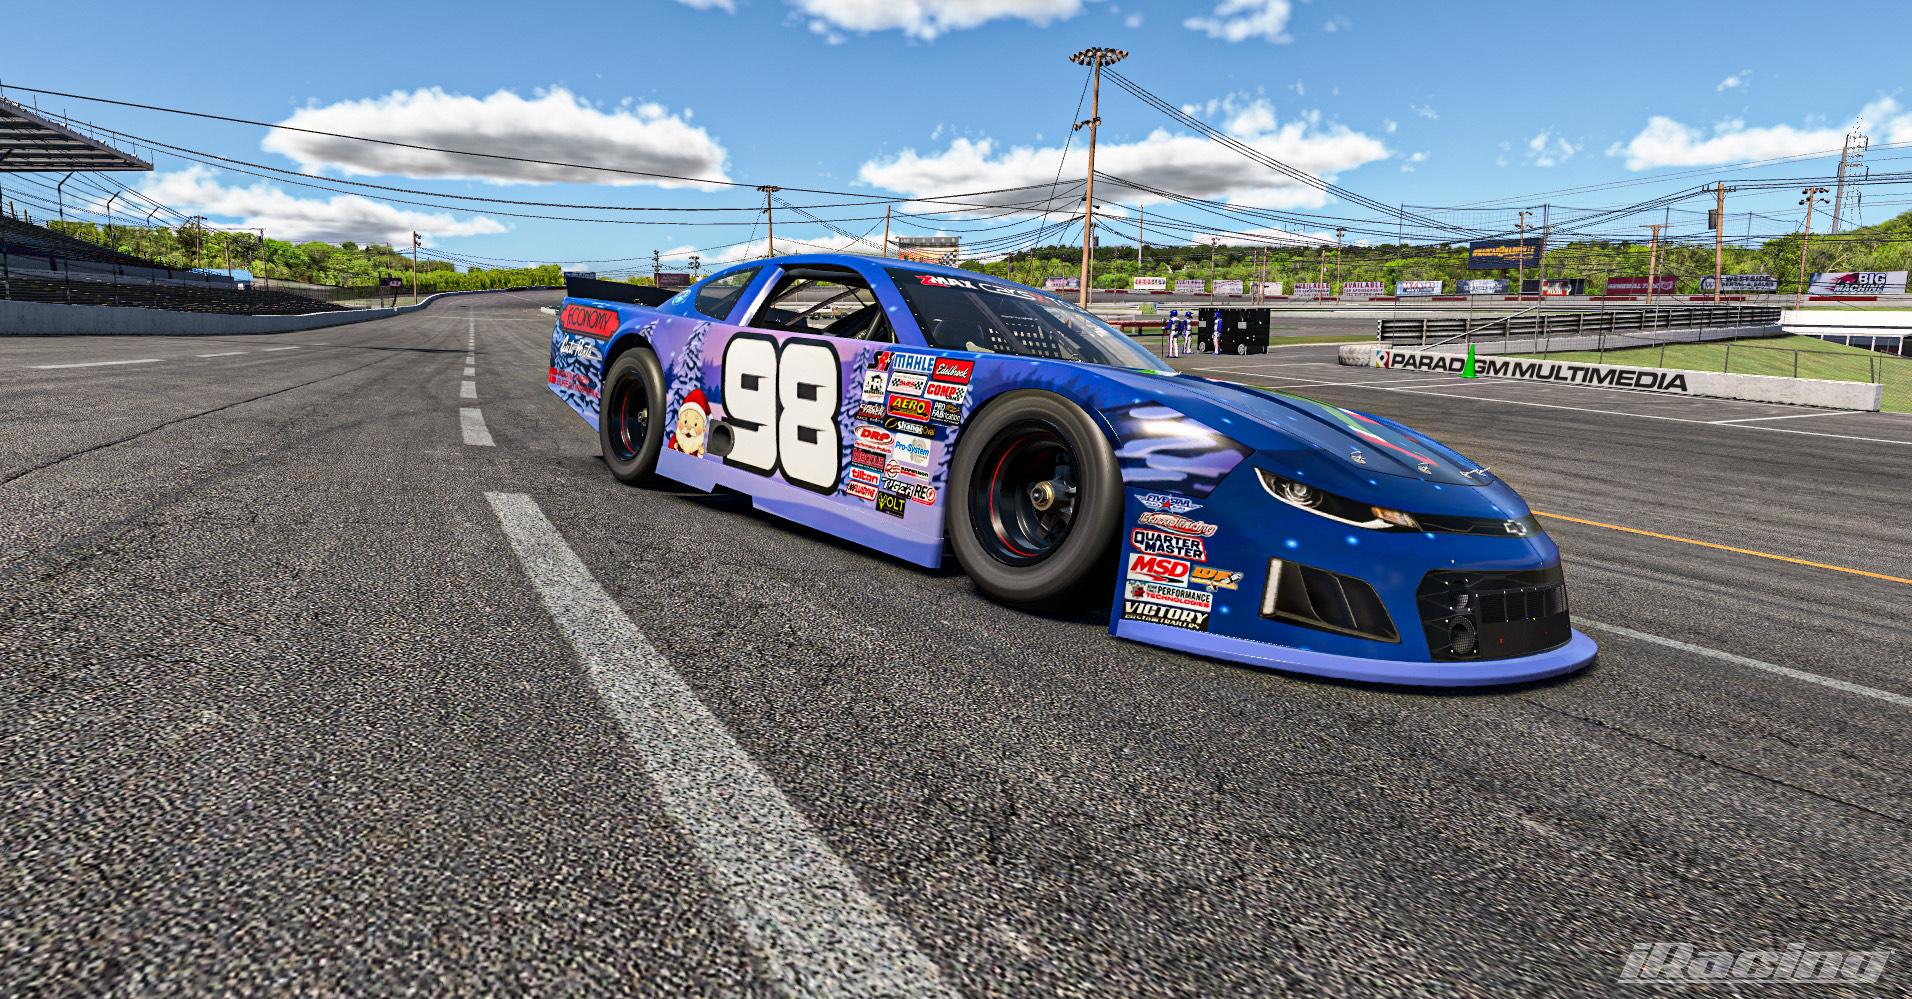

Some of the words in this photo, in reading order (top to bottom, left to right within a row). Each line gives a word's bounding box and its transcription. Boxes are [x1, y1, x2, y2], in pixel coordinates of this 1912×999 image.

[1858, 273, 1887, 284] BIG
[1834, 284, 1885, 293] MACHINE
[567, 307, 613, 330] ECONOMY
[893, 354, 934, 373] MAHLE
[936, 363, 969, 379] Edelbrock
[1391, 353, 1510, 376] PARADGM
[1511, 362, 1688, 392] MULTIMEDIA
[926, 383, 957, 398] COMP
[722, 332, 842, 496] 98
[893, 397, 926, 414] AERO
[934, 401, 946, 411] PRO
[861, 428, 891, 442] DRP
[895, 440, 930, 456] Pro-System
[851, 468, 879, 485] tilton
[878, 492, 906, 512] VOLT
[1134, 530, 1201, 550] QUARTER
[1144, 541, 1203, 560] MASTER
[1130, 555, 1190, 578] MSD
[1146, 592, 1210, 608] TECHNOLOGIES
[1157, 586, 1211, 603] PERFORMANCE
[1125, 601, 1209, 624] VICTORY
